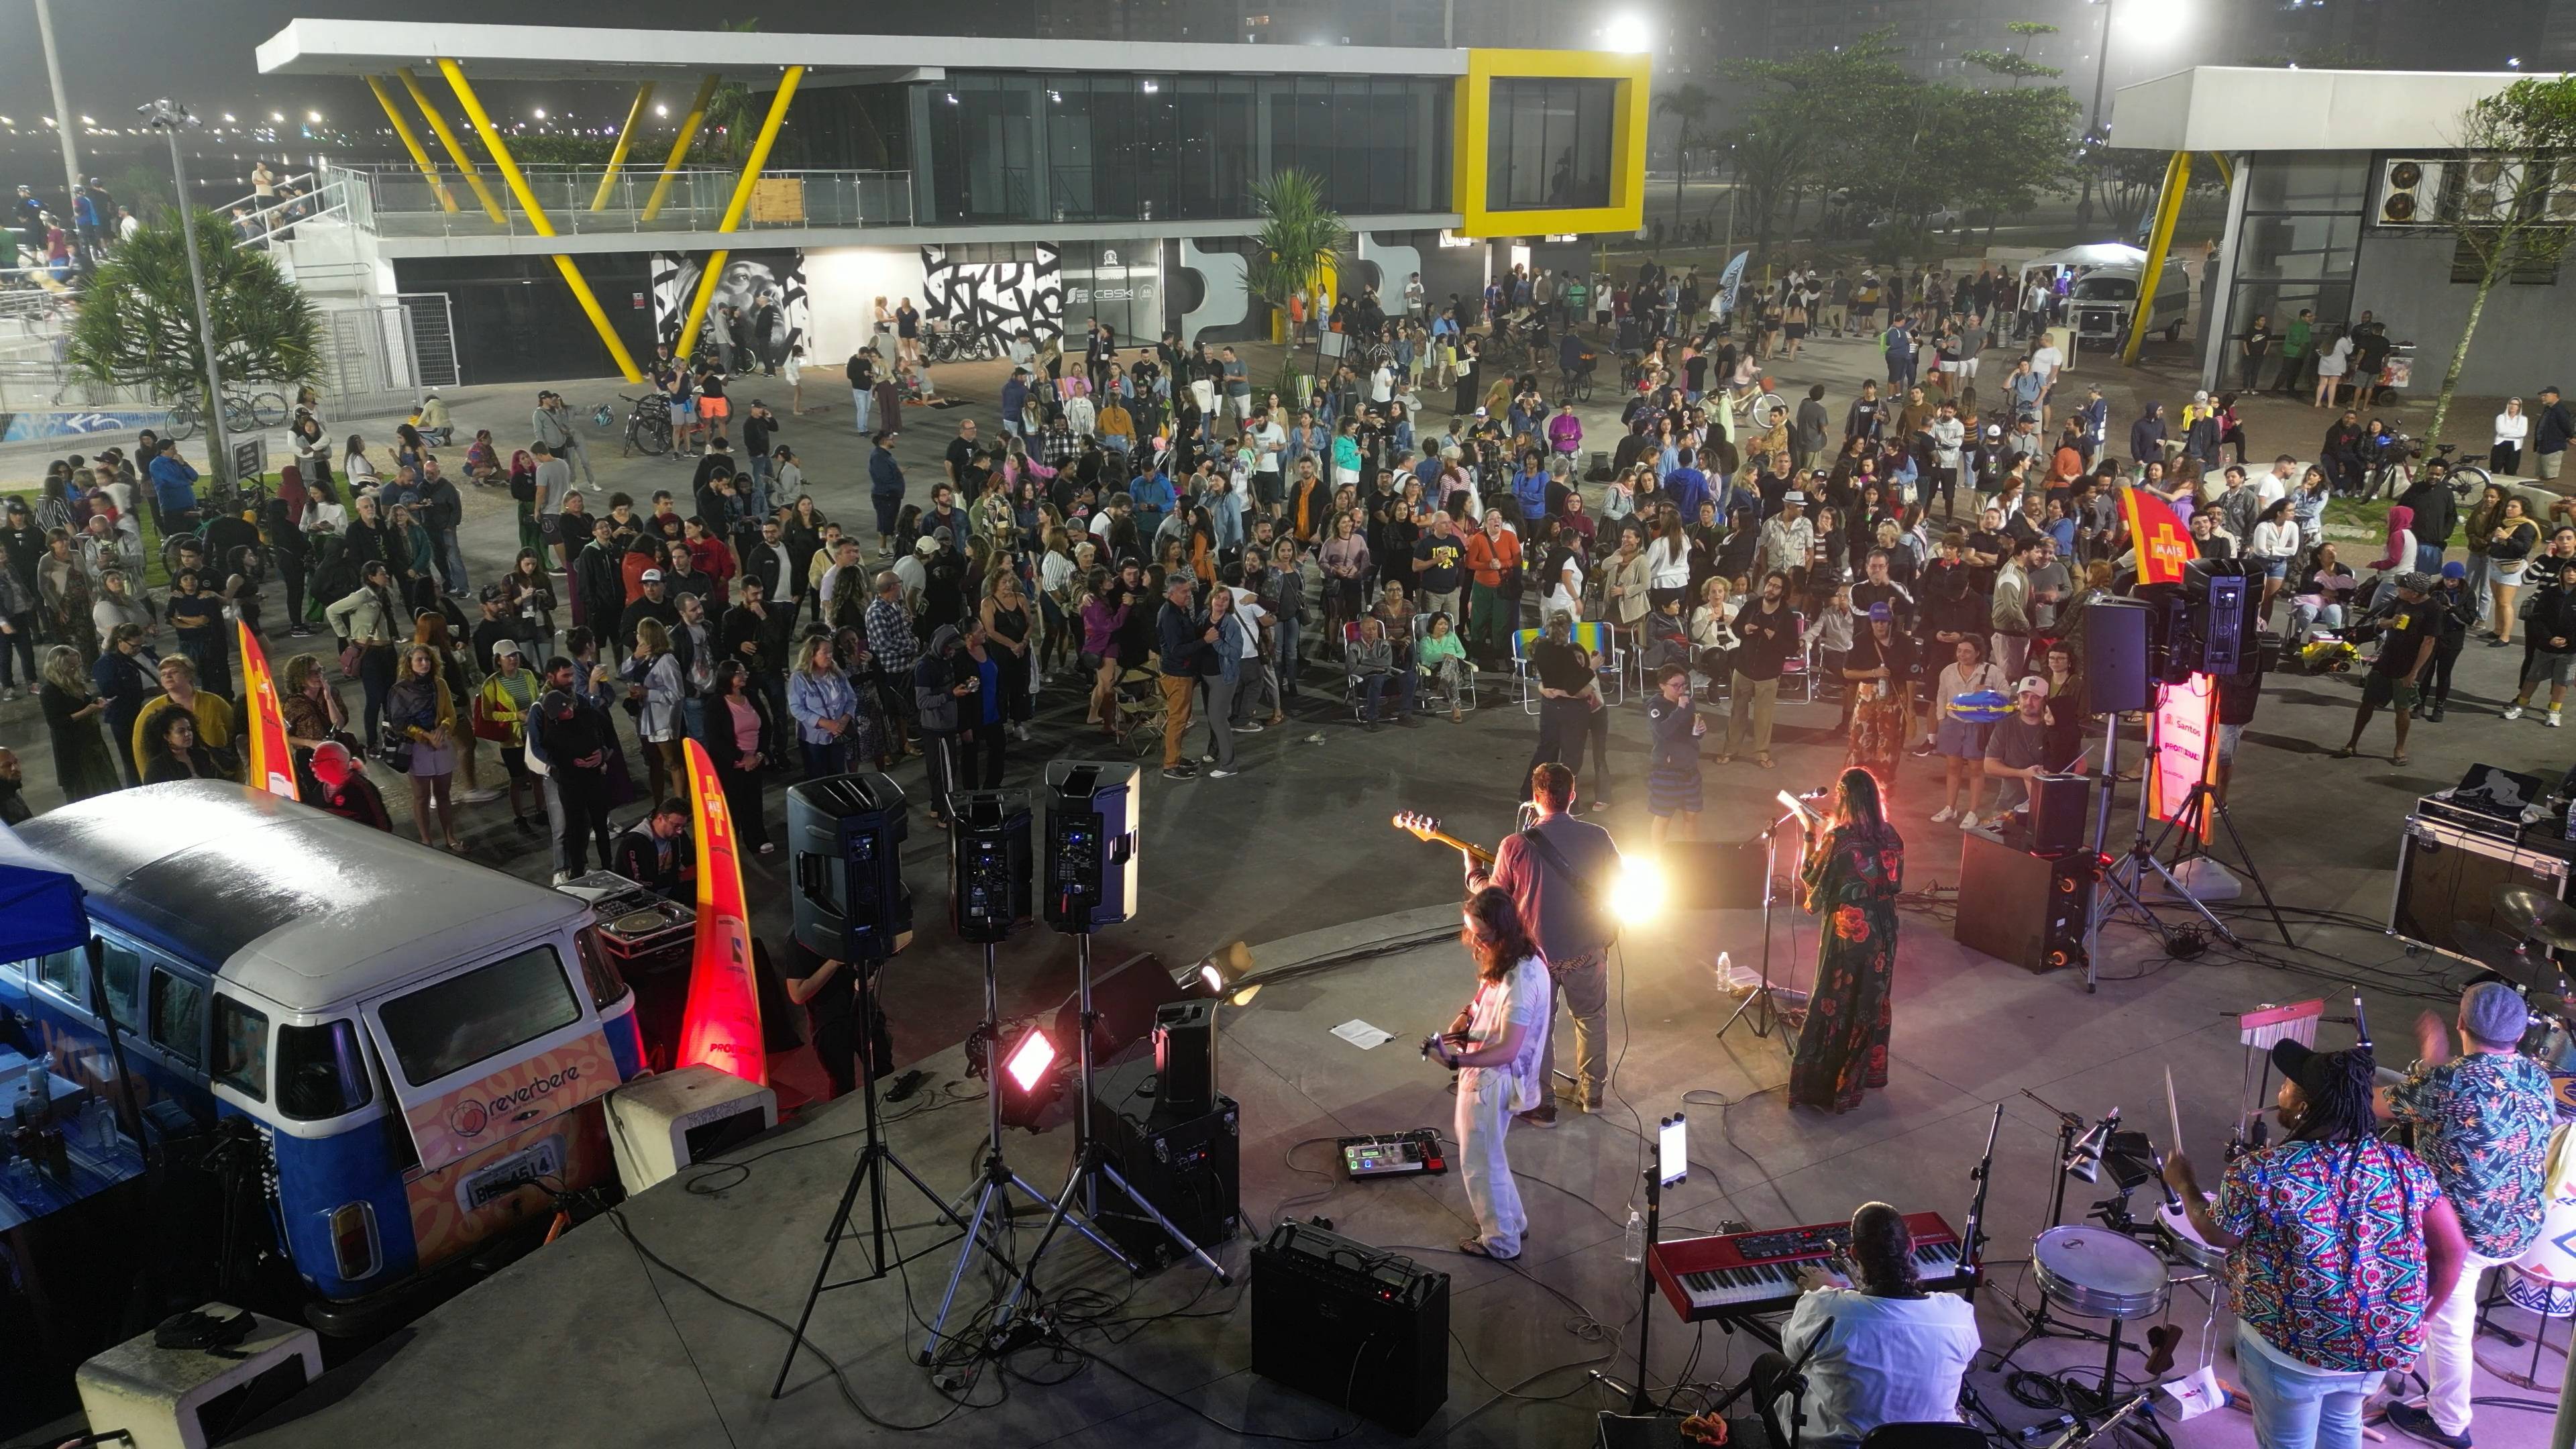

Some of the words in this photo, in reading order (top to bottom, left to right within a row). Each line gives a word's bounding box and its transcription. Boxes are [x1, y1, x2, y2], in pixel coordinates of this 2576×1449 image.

[1093, 288, 1133, 299] CBSK
[2156, 543, 2183, 557] MAIS
[2176, 720, 2201, 737] Santos
[488, 1066, 580, 1116] reverbere
